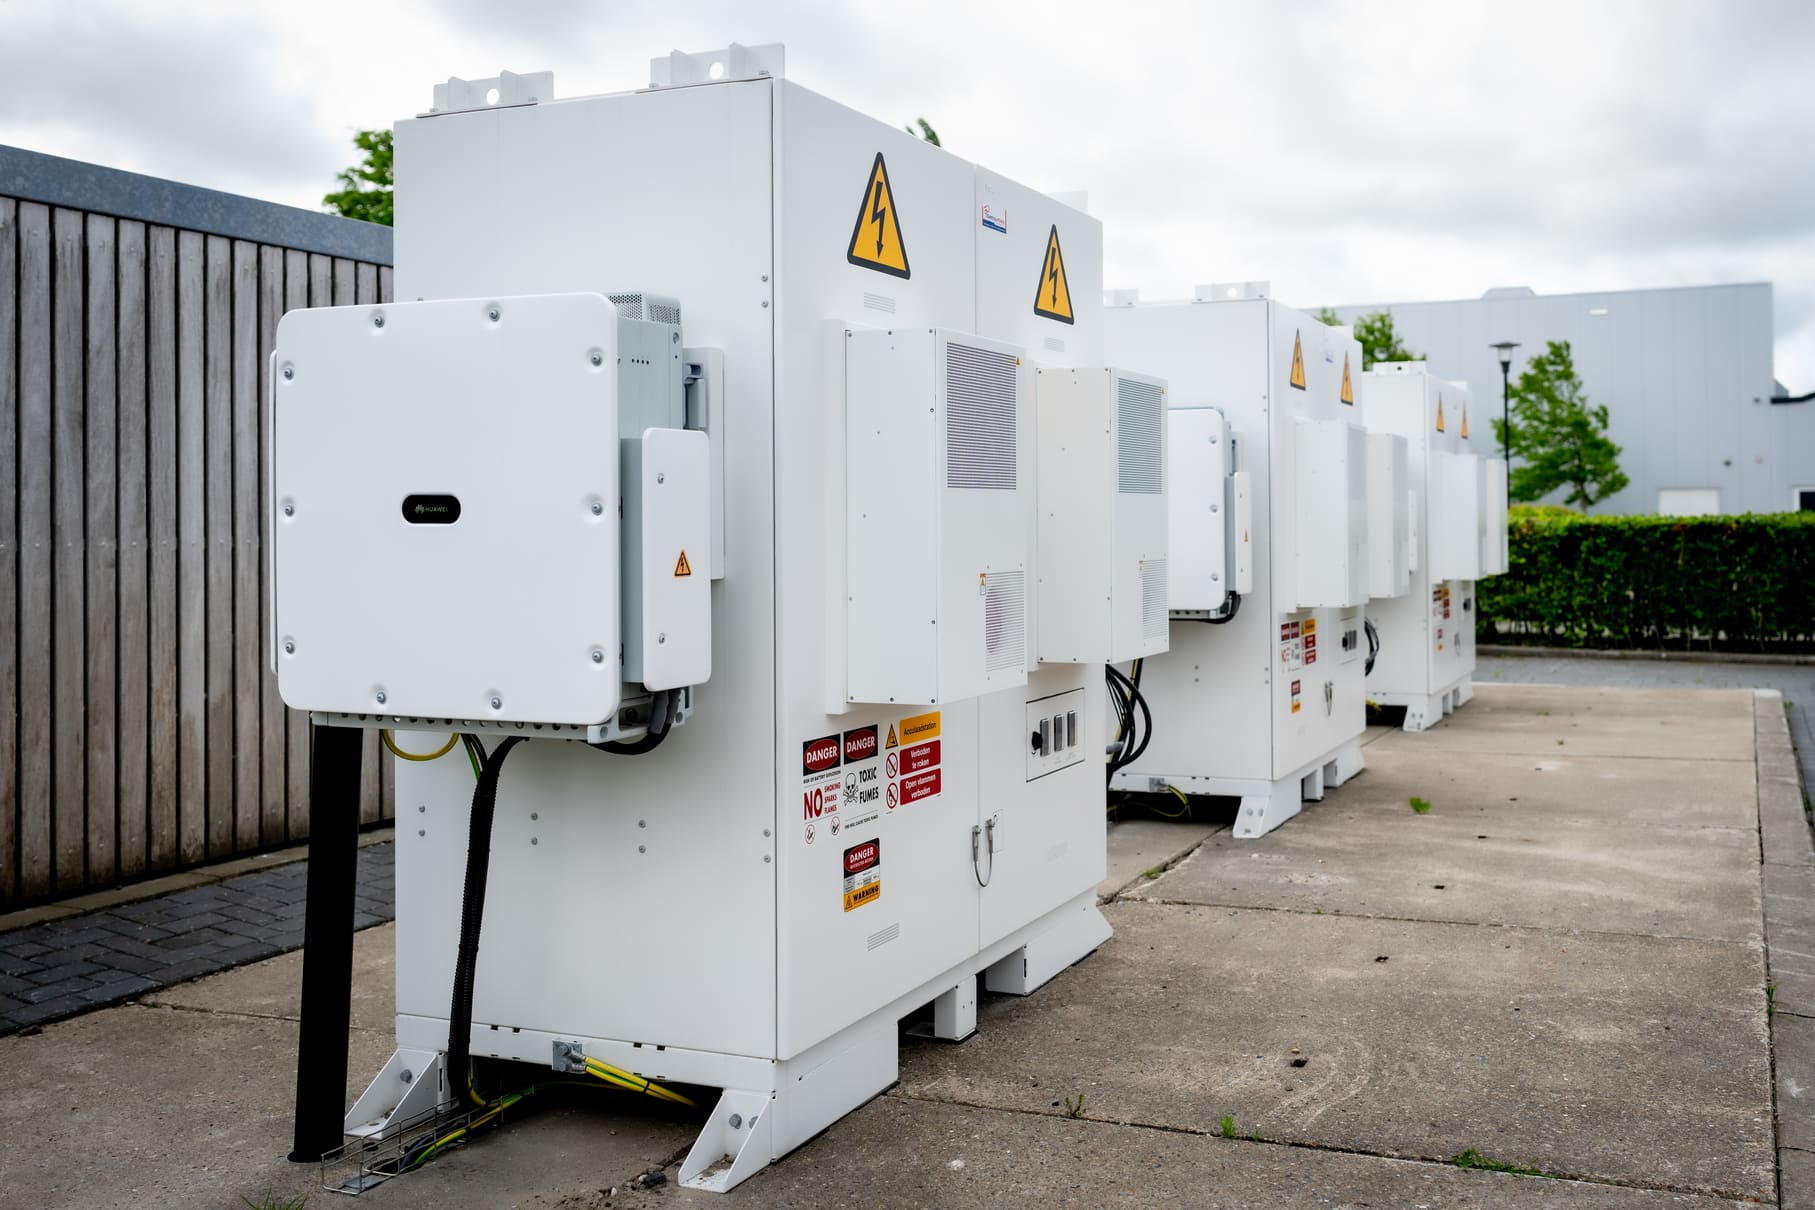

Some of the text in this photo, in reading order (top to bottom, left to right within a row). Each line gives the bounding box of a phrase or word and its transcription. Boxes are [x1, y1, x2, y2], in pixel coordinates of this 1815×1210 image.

[424, 505, 449, 513] HUAWEI
[847, 735, 876, 753] DANGER
[806, 745, 838, 764] DANGER
[910, 747, 931, 758] Verboden
[917, 758, 930, 768] roken
[859, 766, 877, 783] TOXIC
[824, 782, 841, 793] SMOKING
[905, 780, 917, 790] Open
[824, 794, 837, 803] SPARKS
[859, 786, 879, 804] FUMES
[911, 787, 931, 799] verboden
[804, 788, 823, 821] NO
[824, 804, 837, 814] FLAMES
[849, 846, 874, 864] DANGER
[853, 885, 879, 902] WARNING
